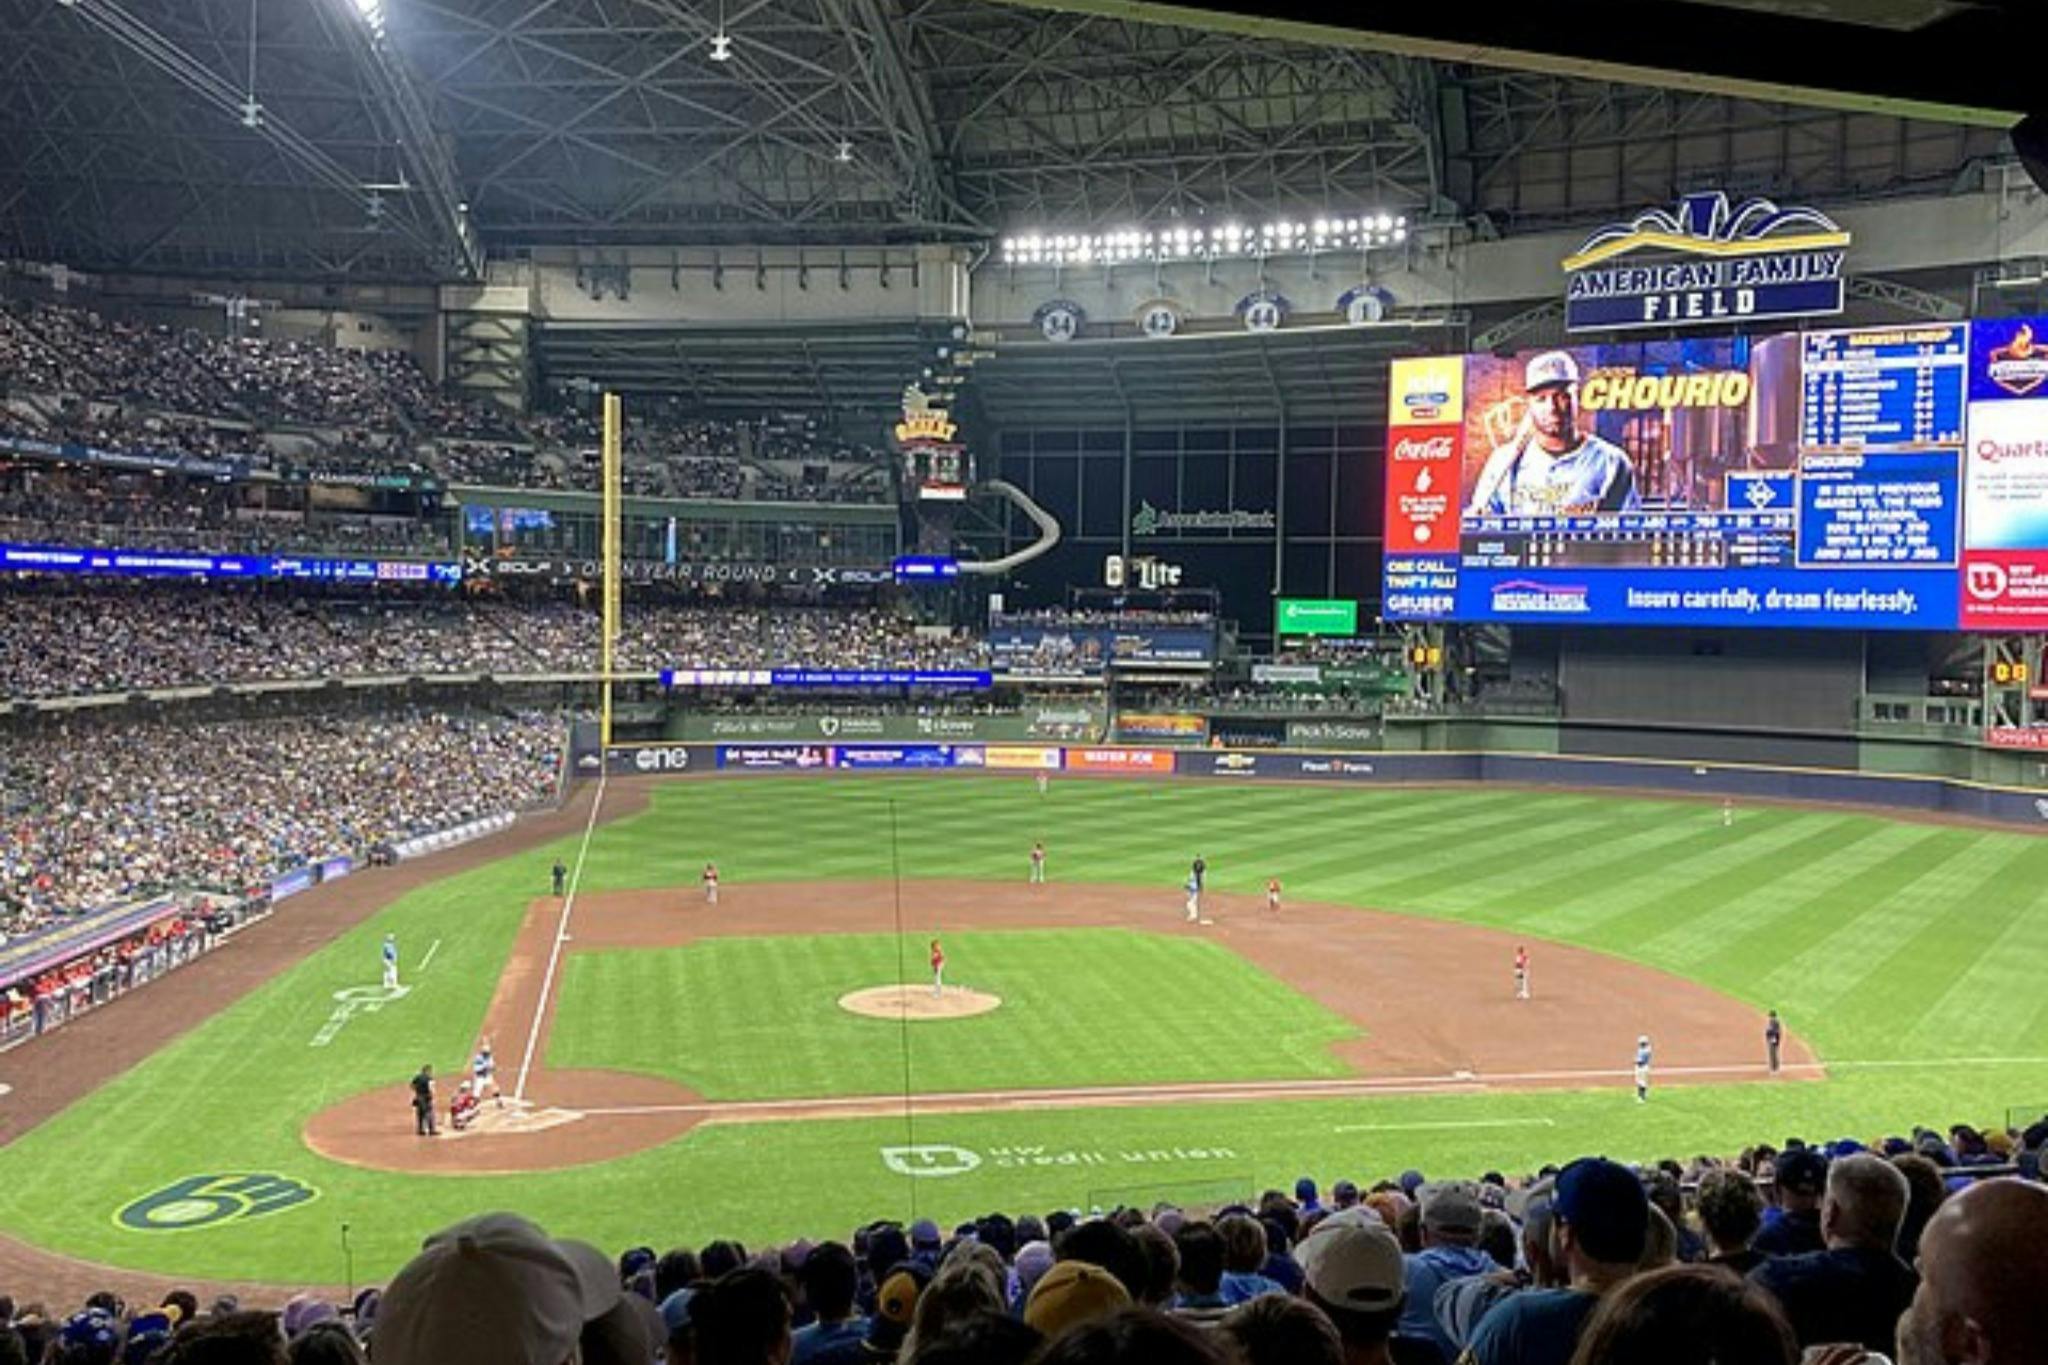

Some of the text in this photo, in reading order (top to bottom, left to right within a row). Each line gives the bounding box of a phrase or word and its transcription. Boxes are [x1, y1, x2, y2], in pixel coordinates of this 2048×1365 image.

[1570, 252, 1844, 297] AMERICAN FAMILY
[1644, 290, 1756, 320] FIELD
[1581, 372, 1751, 410] CHOURIO
[642, 563, 691, 579] YEAR
[703, 565, 776, 582] ROUND
[1134, 555, 1182, 589] Lite
[1387, 561, 1415, 573] ONE
[1388, 594, 1454, 611] GRUBER
[1628, 587, 1918, 614] Insure carefully, dream fearlessly.
[1291, 723, 1322, 738] Pick
[1335, 725, 1371, 739] Save
[1084, 751, 1127, 762] WATER
[1120, 1146, 1237, 1162] union
